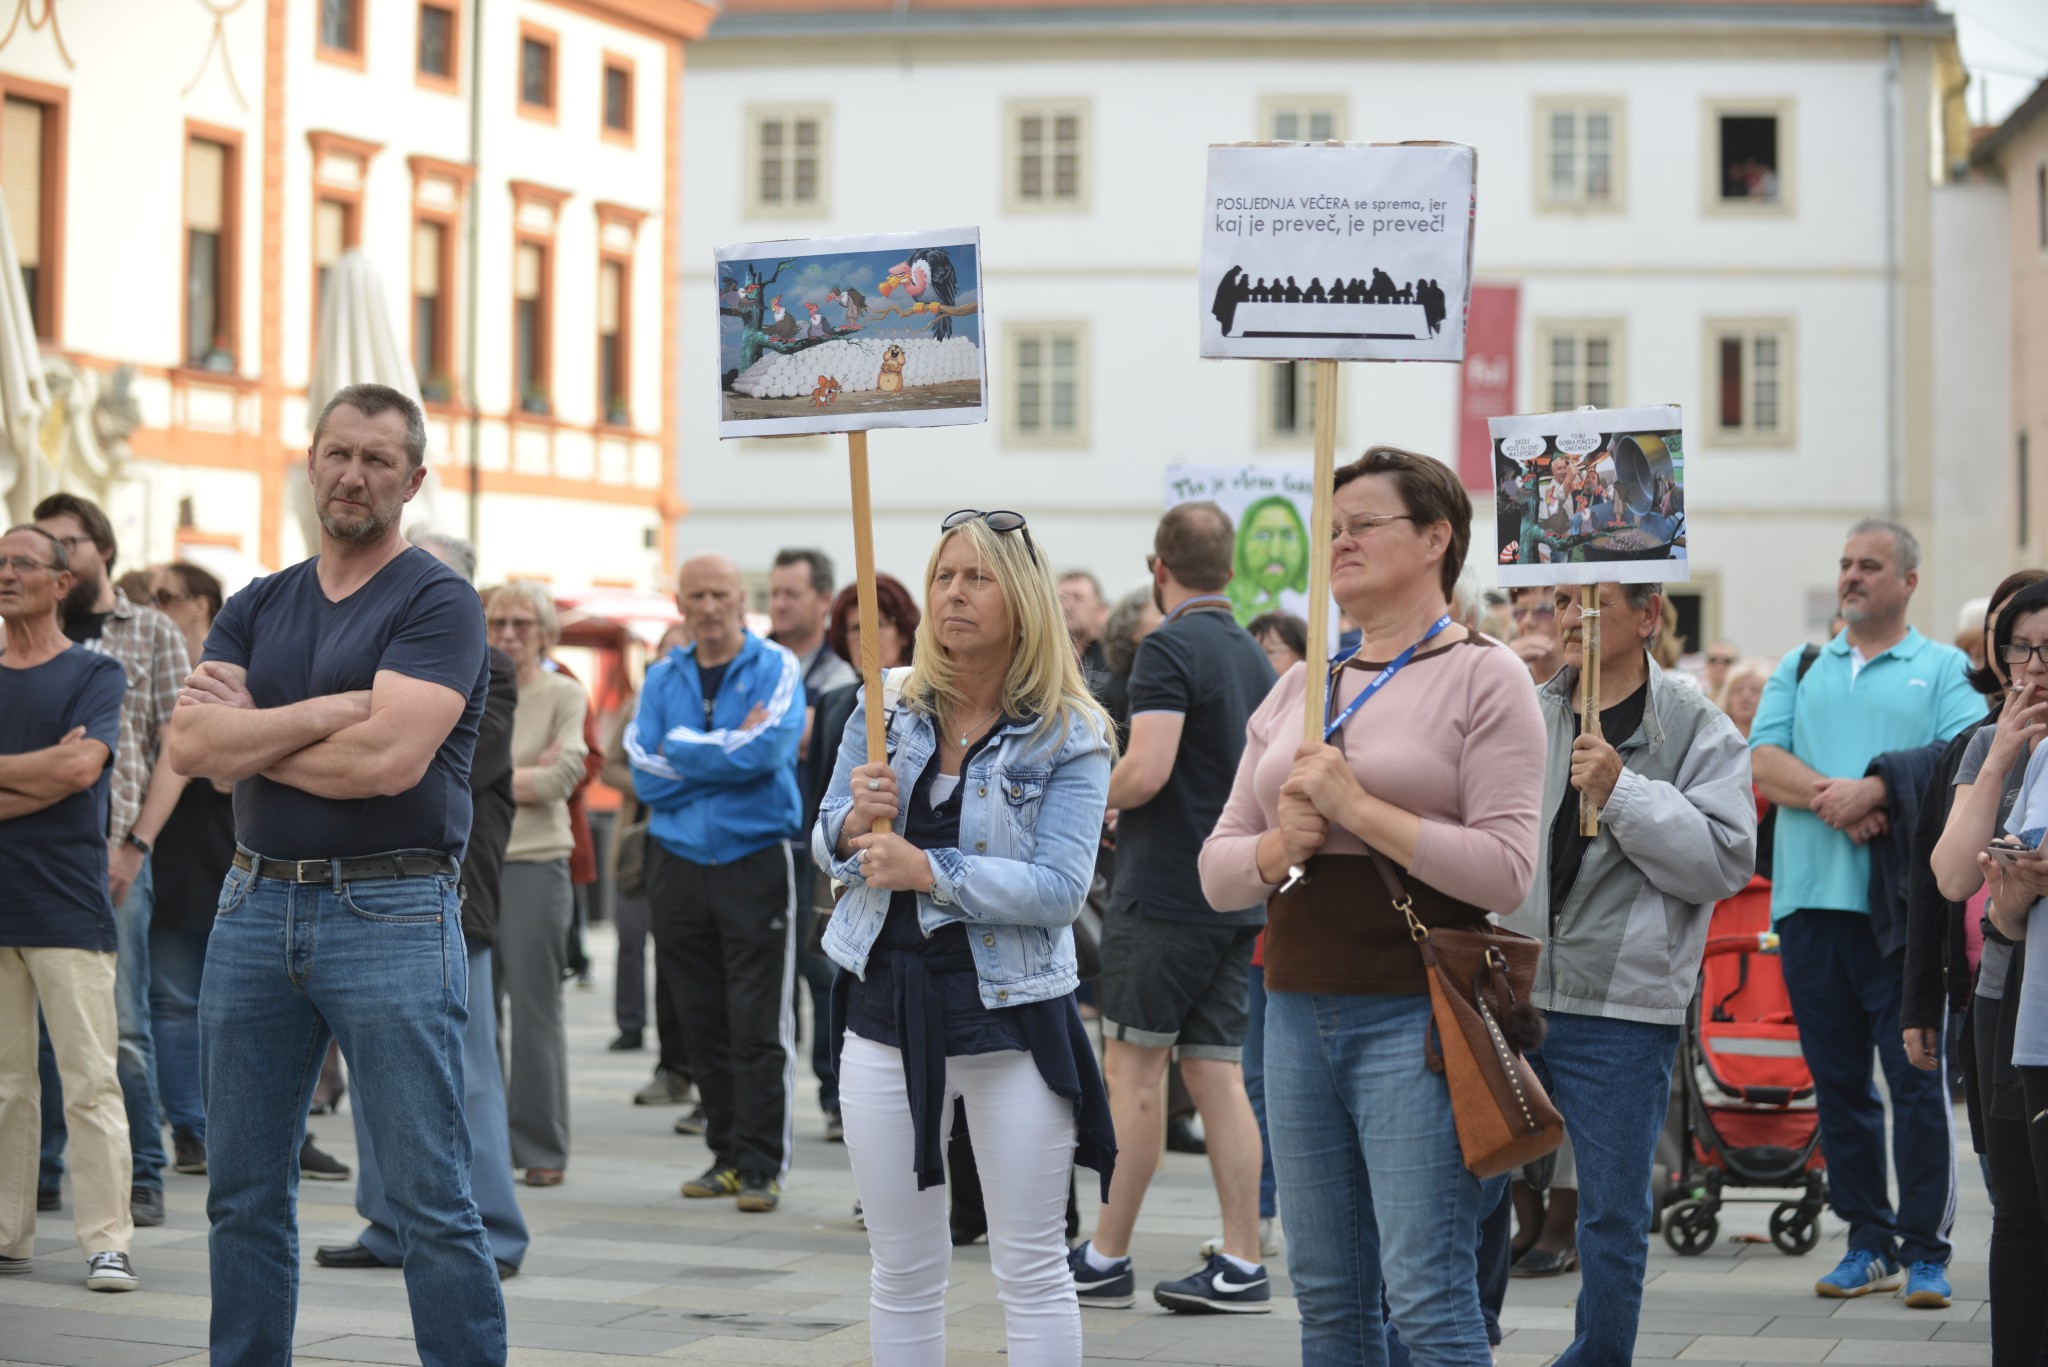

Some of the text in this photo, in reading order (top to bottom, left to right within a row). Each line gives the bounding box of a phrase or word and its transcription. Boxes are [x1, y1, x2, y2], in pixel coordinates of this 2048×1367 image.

[1216, 193, 1447, 213] POSLJEDNJA VEČERA se sprema, jer
[1216, 213, 1445, 236] kaj je preveč, je preveč!
